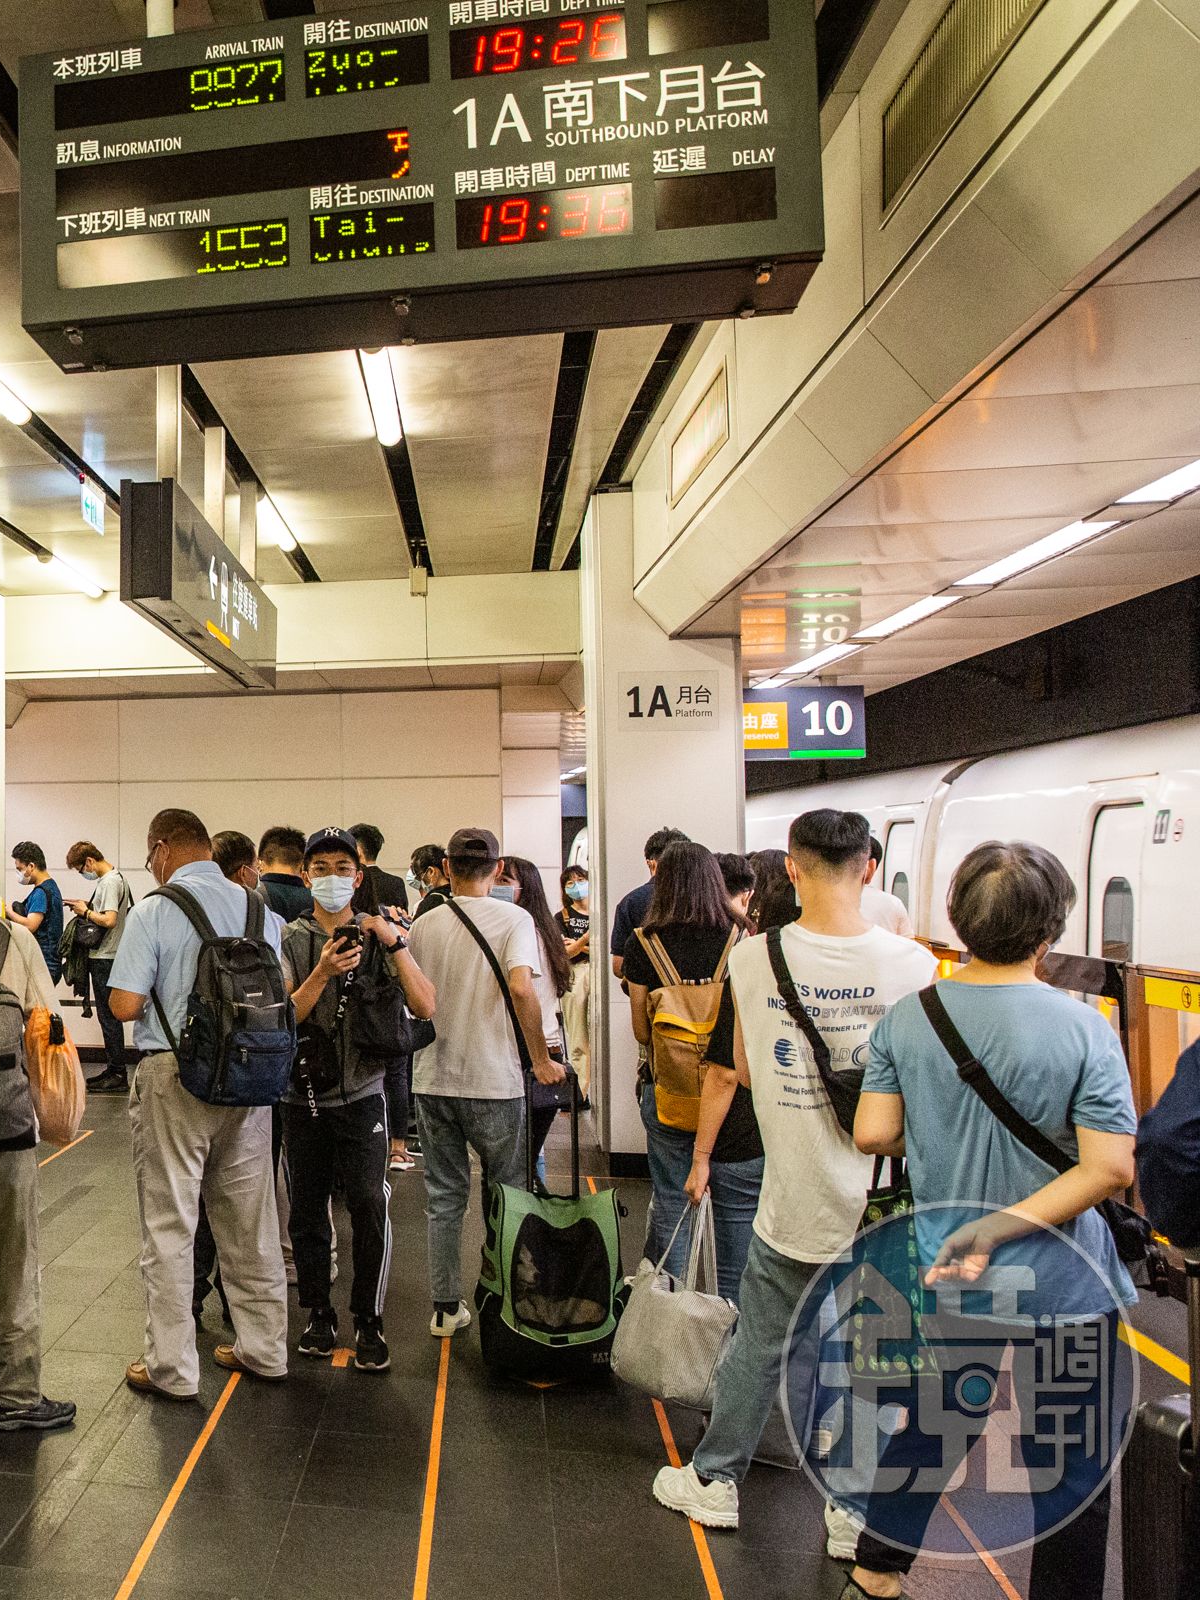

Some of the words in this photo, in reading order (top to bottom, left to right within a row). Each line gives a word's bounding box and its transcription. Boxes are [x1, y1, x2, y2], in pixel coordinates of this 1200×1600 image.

[449, 0, 549, 25] 開車時間
[303, 19, 351, 46] 開往
[354, 17, 429, 40] DESTINATION
[205, 40, 249, 60] ARRIVAL
[251, 36, 284, 54] TRAIN
[473, 14, 621, 72] 19:26
[53, 48, 143, 80] 本班列車
[542, 60, 766, 130] 南下月台
[452, 93, 532, 149] 1A
[546, 120, 669, 148] SOUTHBOUND
[675, 109, 768, 134] PLATFORM
[56, 140, 100, 165] 訊息
[103, 137, 182, 159] INFORMATION
[653, 146, 707, 174] 延遲
[732, 147, 776, 167] DELAY
[454, 161, 556, 195] 開車時間
[565, 166, 597, 183] DEPT
[599, 162, 630, 179] TIME
[309, 183, 357, 210] 開往
[360, 184, 434, 205] DESTINATION
[57, 208, 146, 237] 下班列車
[149, 211, 176, 228] NEXT
[178, 208, 210, 225] TRAIN
[479, 188, 629, 243] 19:36
[626, 685, 673, 718] 1A
[677, 685, 712, 705] 月台
[675, 709, 713, 718] Platform
[801, 700, 853, 736] 10
[814, 987, 875, 1000] WORLD
[767, 997, 820, 1018] INSED
[781, 1020, 794, 1028] THE
